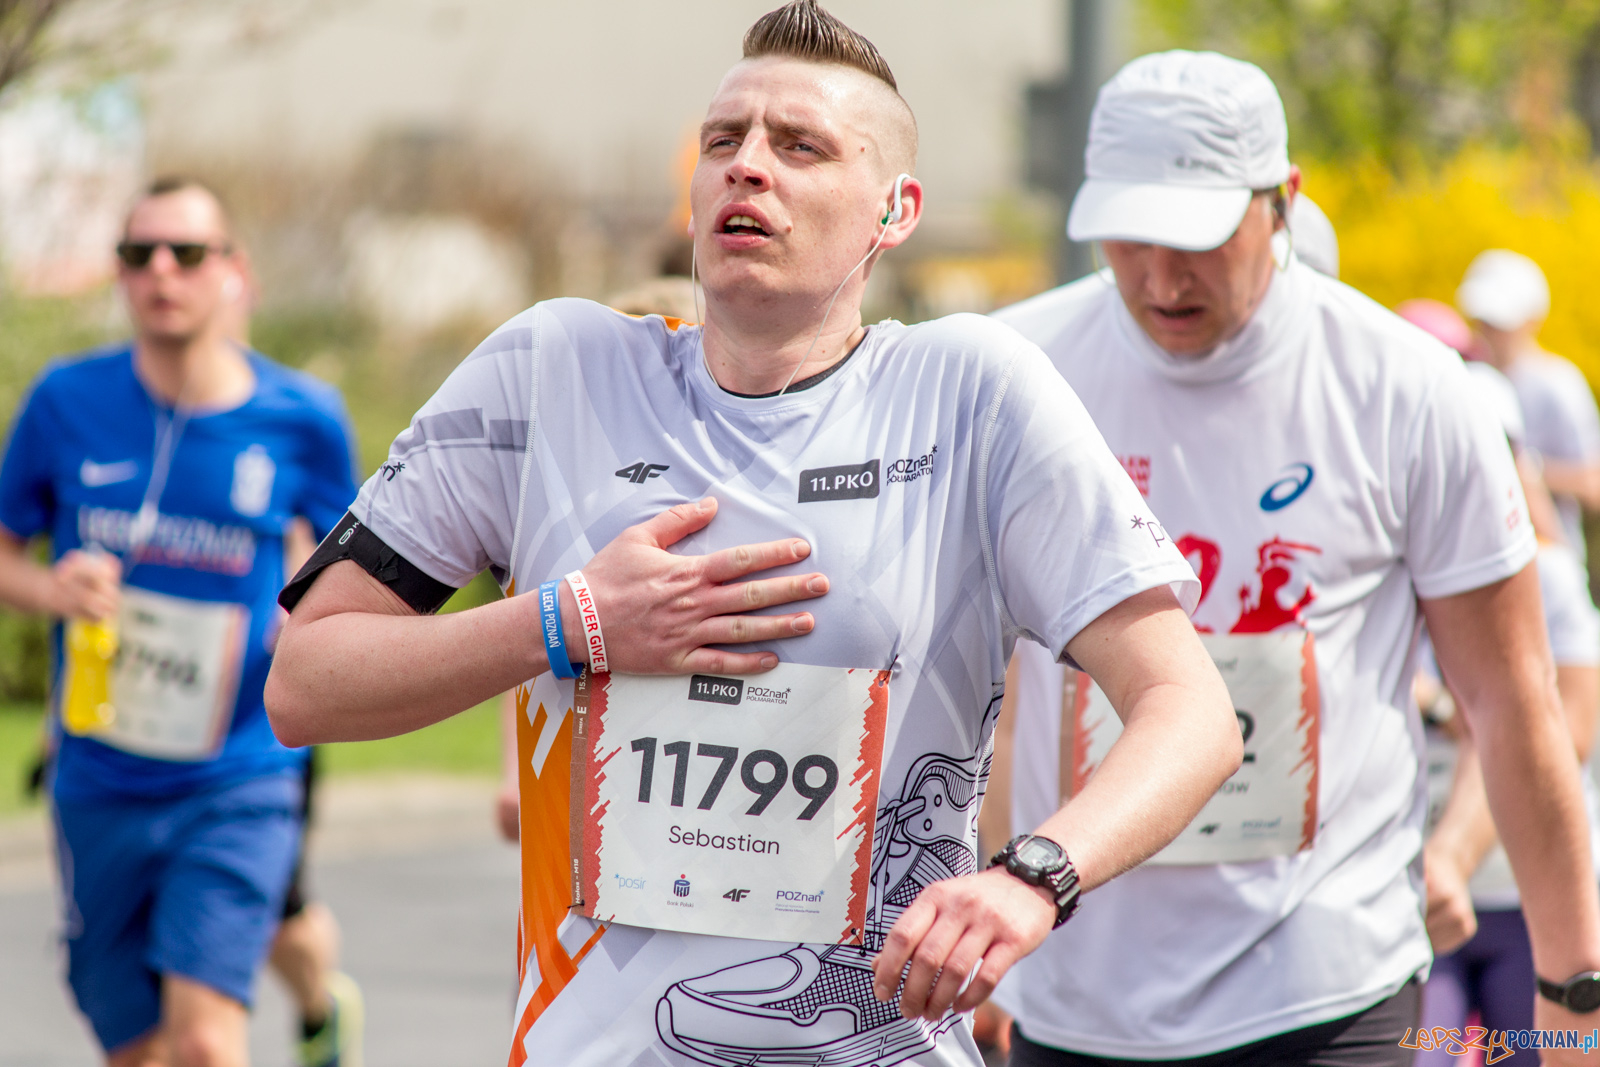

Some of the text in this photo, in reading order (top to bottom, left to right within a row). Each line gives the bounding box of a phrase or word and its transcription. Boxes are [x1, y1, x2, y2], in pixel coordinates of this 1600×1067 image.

[614, 462, 670, 484] 4F
[810, 470, 874, 492] 11. PKO
[542, 591, 555, 612] LECH
[576, 587, 599, 633] NEVER
[589, 635, 606, 664] GIVE
[696, 682, 738, 698] 11. PKO
[576, 706, 587, 714] E
[630, 736, 839, 821] 11799
[668, 825, 780, 855] Sebastian
[722, 888, 751, 903] 4F
